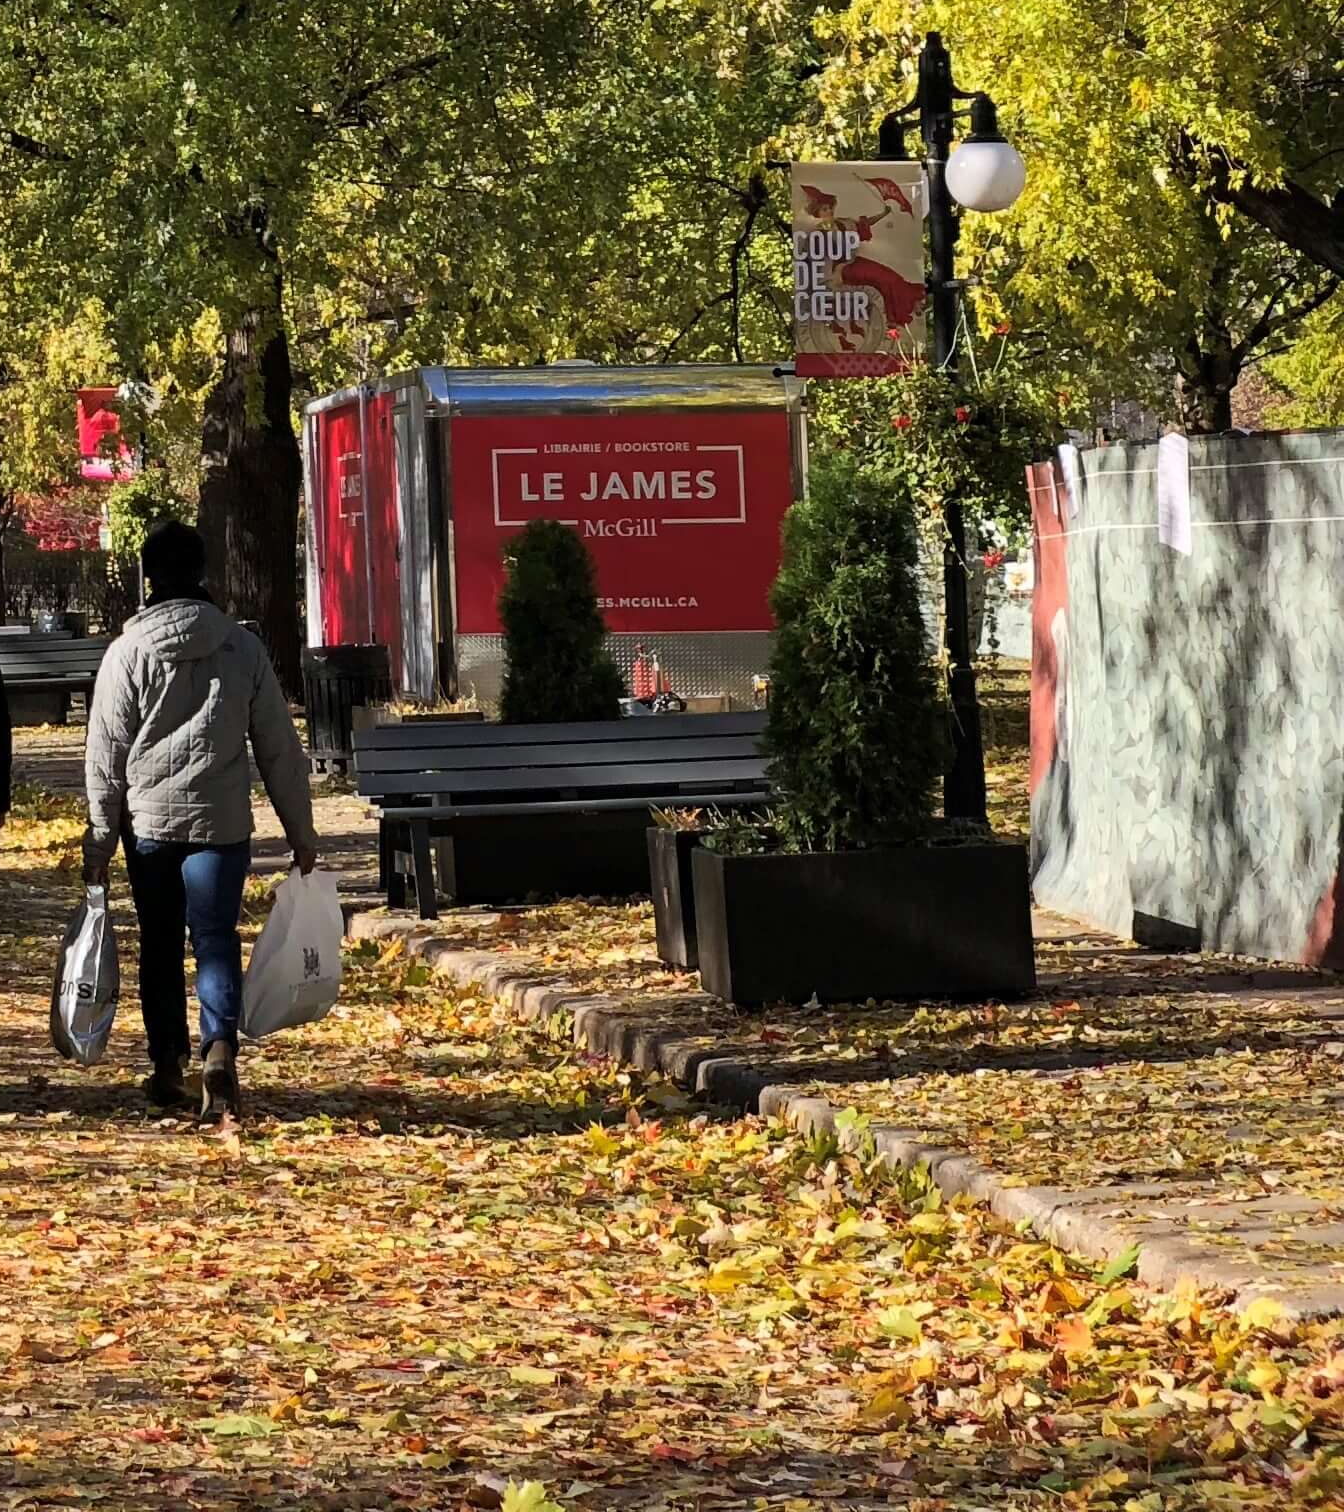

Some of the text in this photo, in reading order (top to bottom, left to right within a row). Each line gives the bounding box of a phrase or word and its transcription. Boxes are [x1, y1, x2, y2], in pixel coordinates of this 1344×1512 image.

[792, 230, 861, 261] COUP
[794, 261, 827, 290] DE
[794, 291, 870, 322] CŒUR
[543, 443, 602, 454] LIBRAIRIE
[614, 442, 690, 453] BOOKSTORE
[520, 470, 717, 501] LE JAMES
[583, 518, 658, 538] McGill
